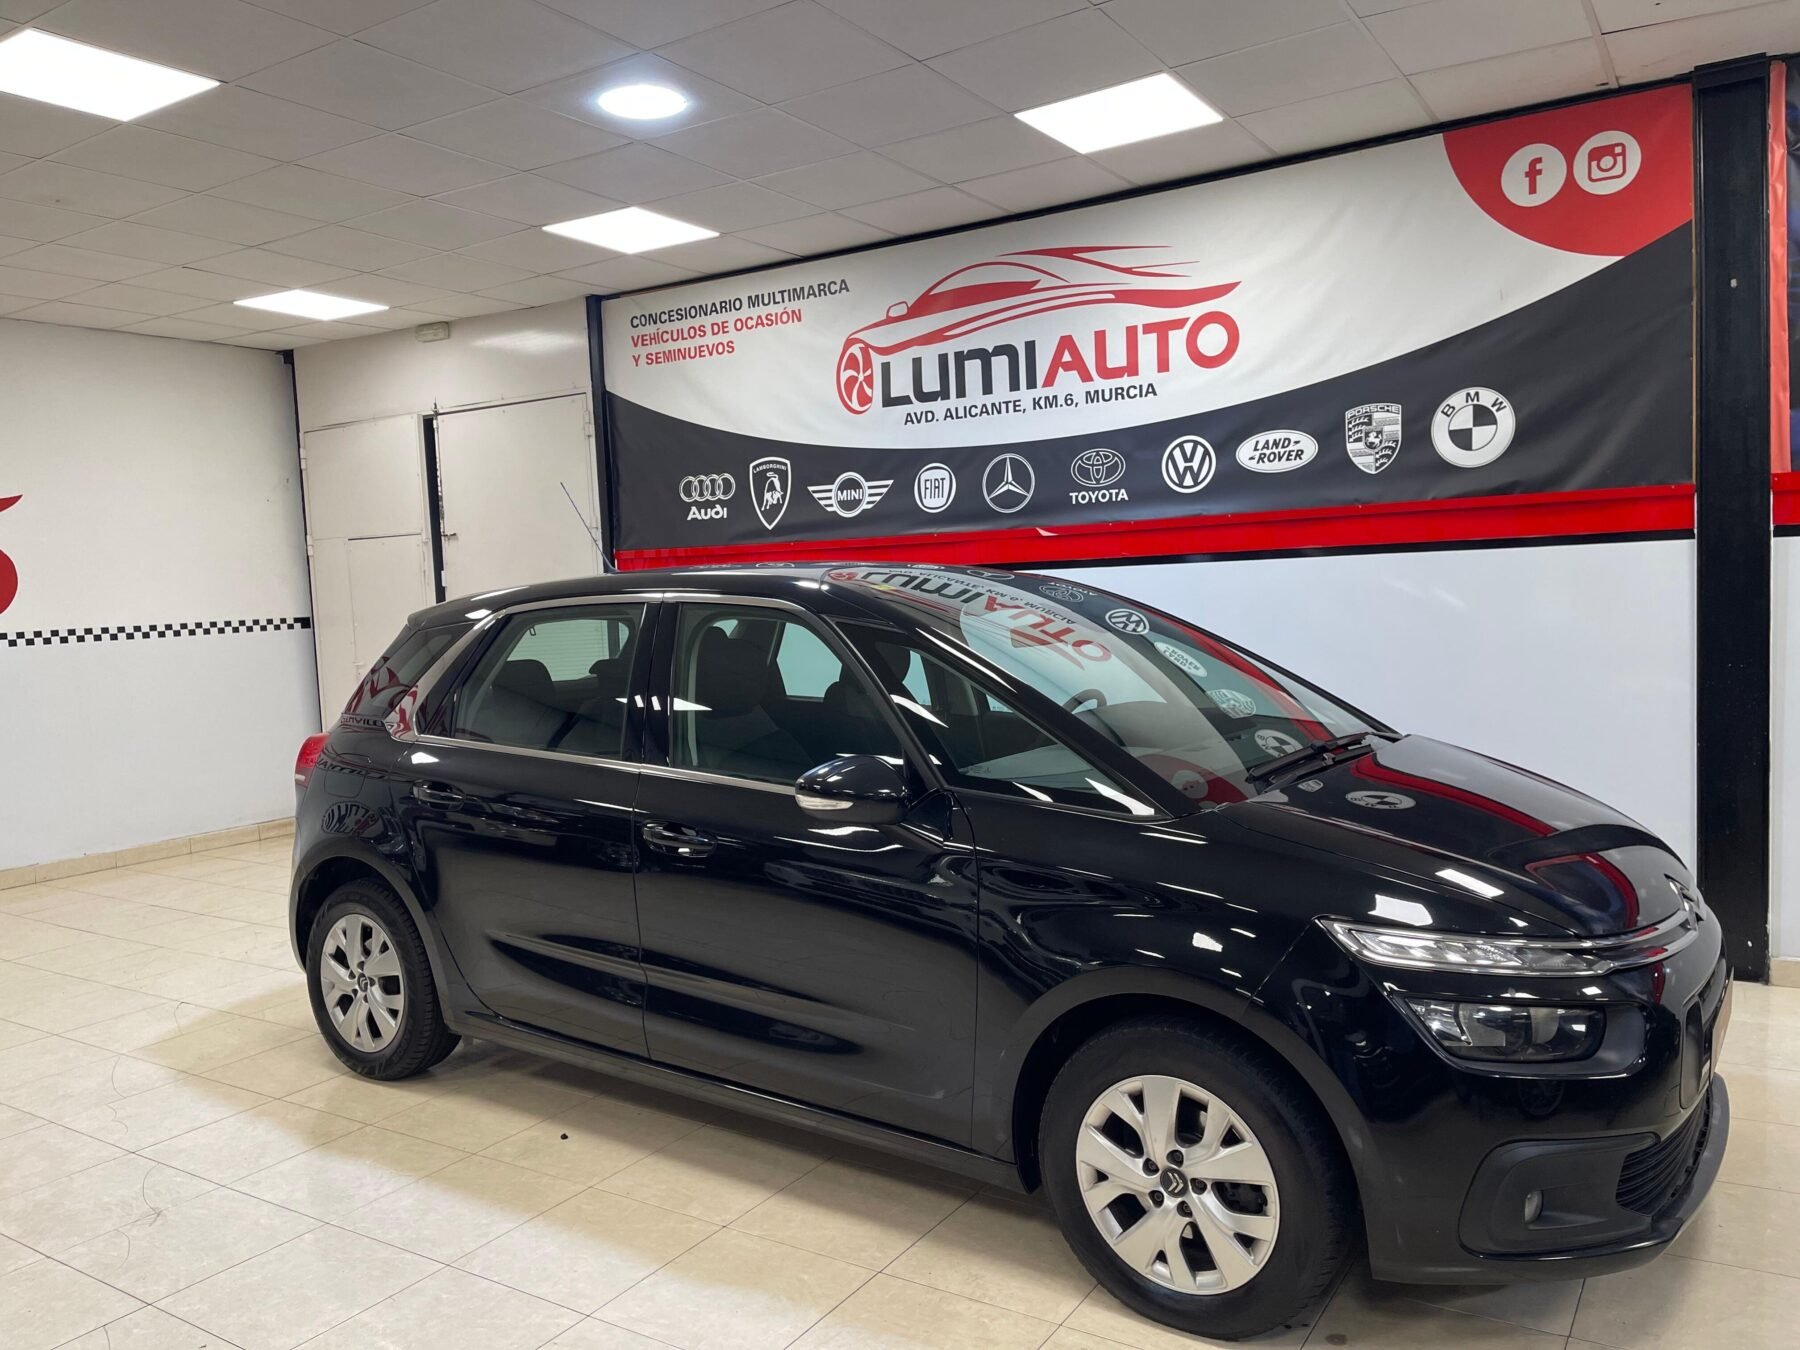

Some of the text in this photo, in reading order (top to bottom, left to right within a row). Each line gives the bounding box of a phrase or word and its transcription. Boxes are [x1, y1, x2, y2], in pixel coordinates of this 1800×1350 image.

[630, 278, 850, 329] CONCESIONARIO MULTIMARCA
[631, 307, 802, 348] VEHÍCULOS DE OCASIÓN
[631, 340, 735, 367] Y SEMINUEVOS
[903, 382, 1158, 426] AVD. ALICANTE, KM.6, MURCIA
[1347, 404, 1400, 420] PORSCHE
[1440, 391, 1507, 418] BMW
[1256, 449, 1304, 465] ROVER
[753, 463, 787, 474] LAMBORGHINI
[837, 488, 863, 502] MINI
[924, 476, 946, 499] FIAT
[1069, 488, 1129, 505] TOYOTA
[687, 504, 727, 521] Audi
